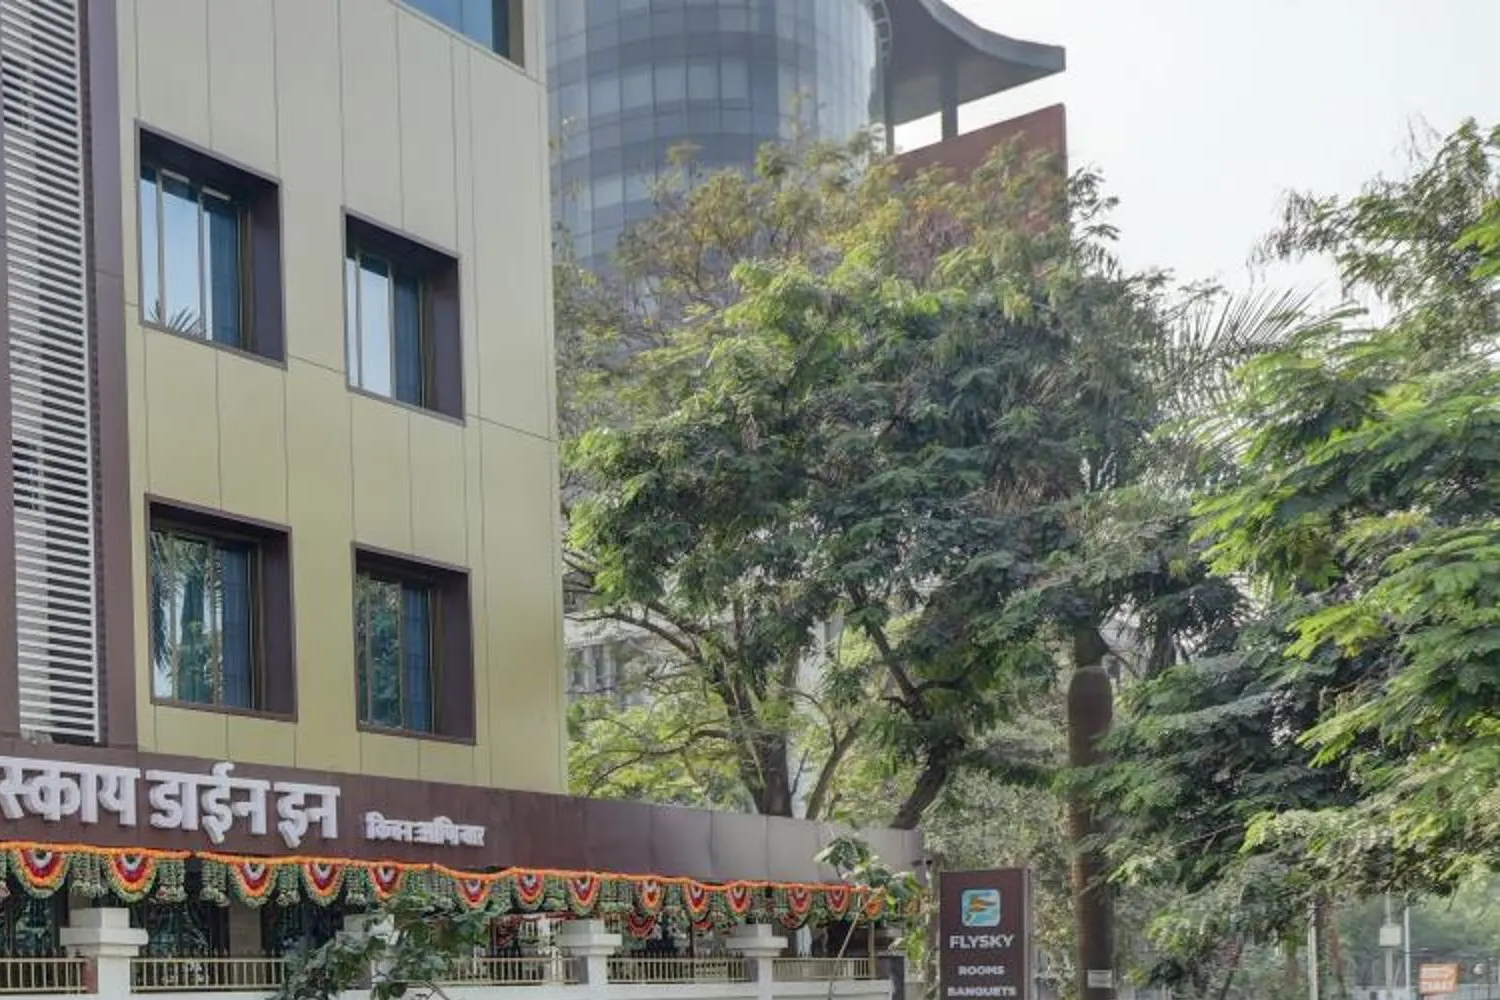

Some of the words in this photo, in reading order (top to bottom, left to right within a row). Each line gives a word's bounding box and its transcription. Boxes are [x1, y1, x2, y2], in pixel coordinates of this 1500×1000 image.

[145, 762, 270, 844] डाईन
[273, 781, 340, 849] इन
[949, 934, 1015, 949] FLYSKY
[958, 965, 1005, 975] ROOMS
[947, 986, 1017, 996] BANQUETS
